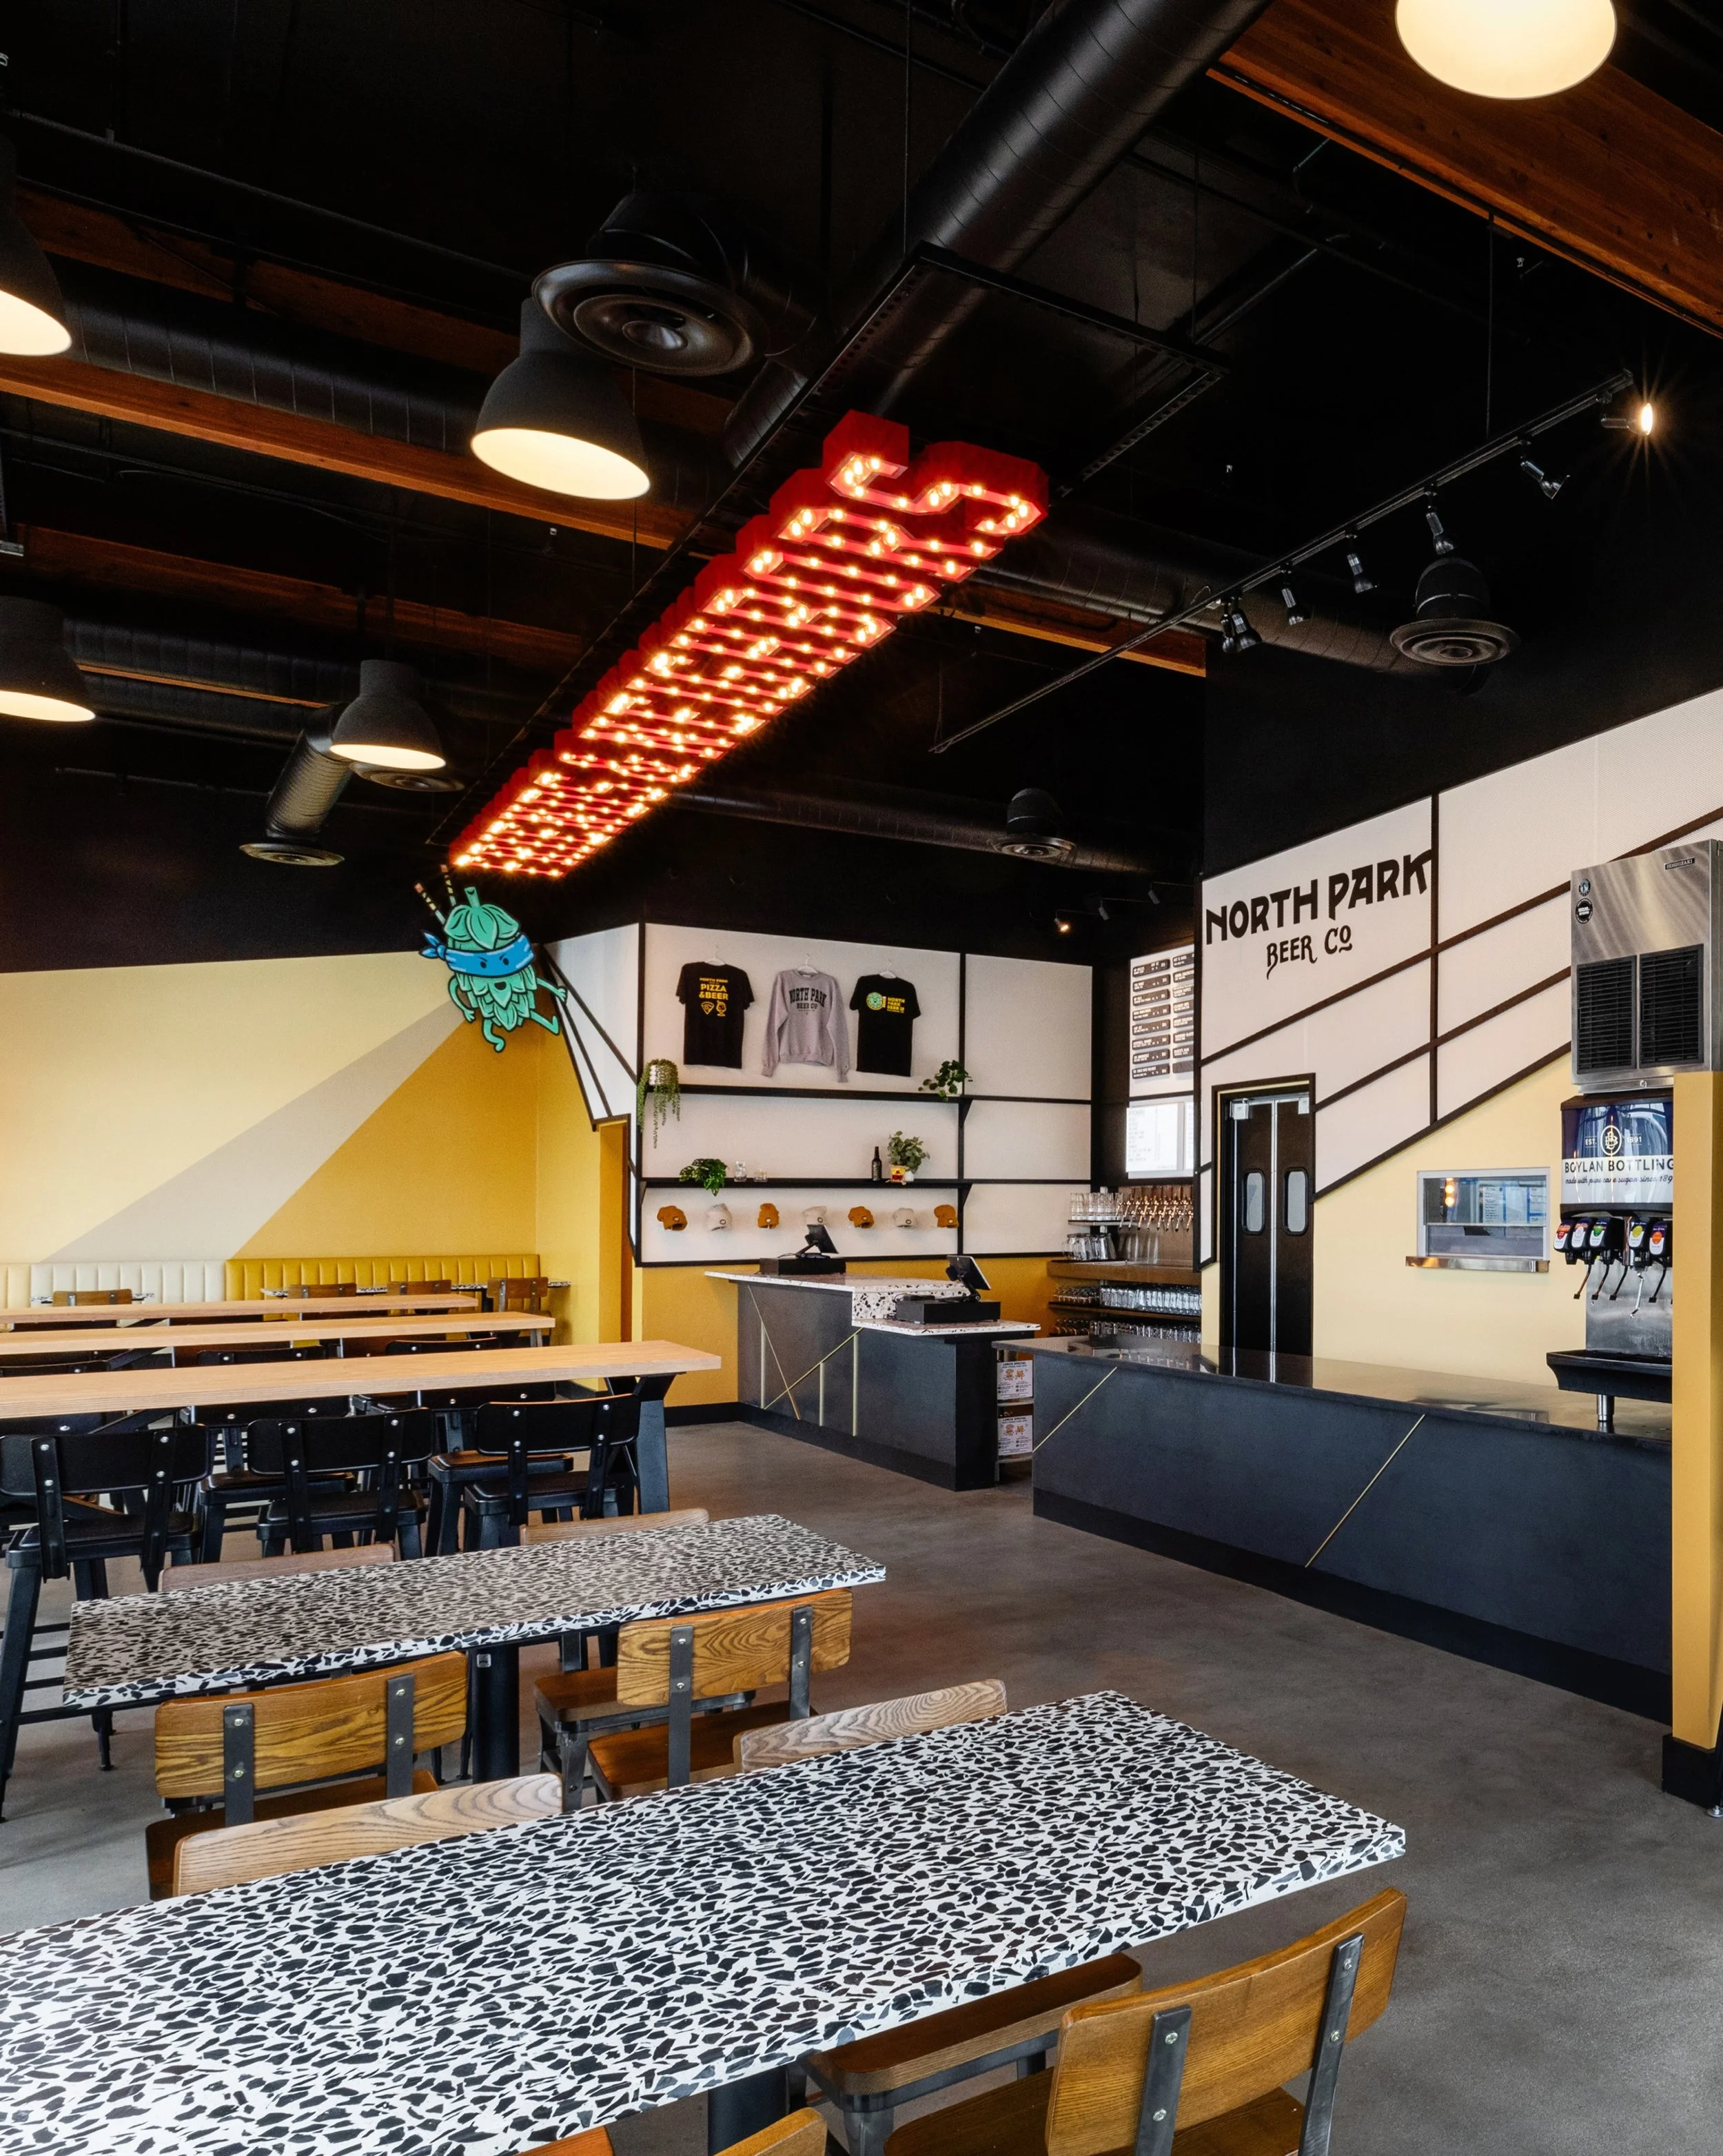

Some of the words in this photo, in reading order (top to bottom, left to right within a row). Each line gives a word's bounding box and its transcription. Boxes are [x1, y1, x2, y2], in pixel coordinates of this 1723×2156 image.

[451, 768, 670, 878] FRIENDS
[575, 448, 1048, 766] NEIGHBORS
[1206, 879, 1318, 945] NORTH
[1329, 849, 1431, 920] PARK
[1266, 935, 1317, 979] BEER
[699, 991, 728, 1000] &BEER
[700, 984, 726, 992] PIZZA
[810, 988, 826, 1007] PARK
[1564, 1161, 1603, 1173] BOYLAN
[1608, 1158, 1673, 1172] BOTTLING
[1578, 1175, 1588, 1183] with
[1618, 1177, 1638, 1186] sugar
[1658, 1174, 1673, 1184] 189
